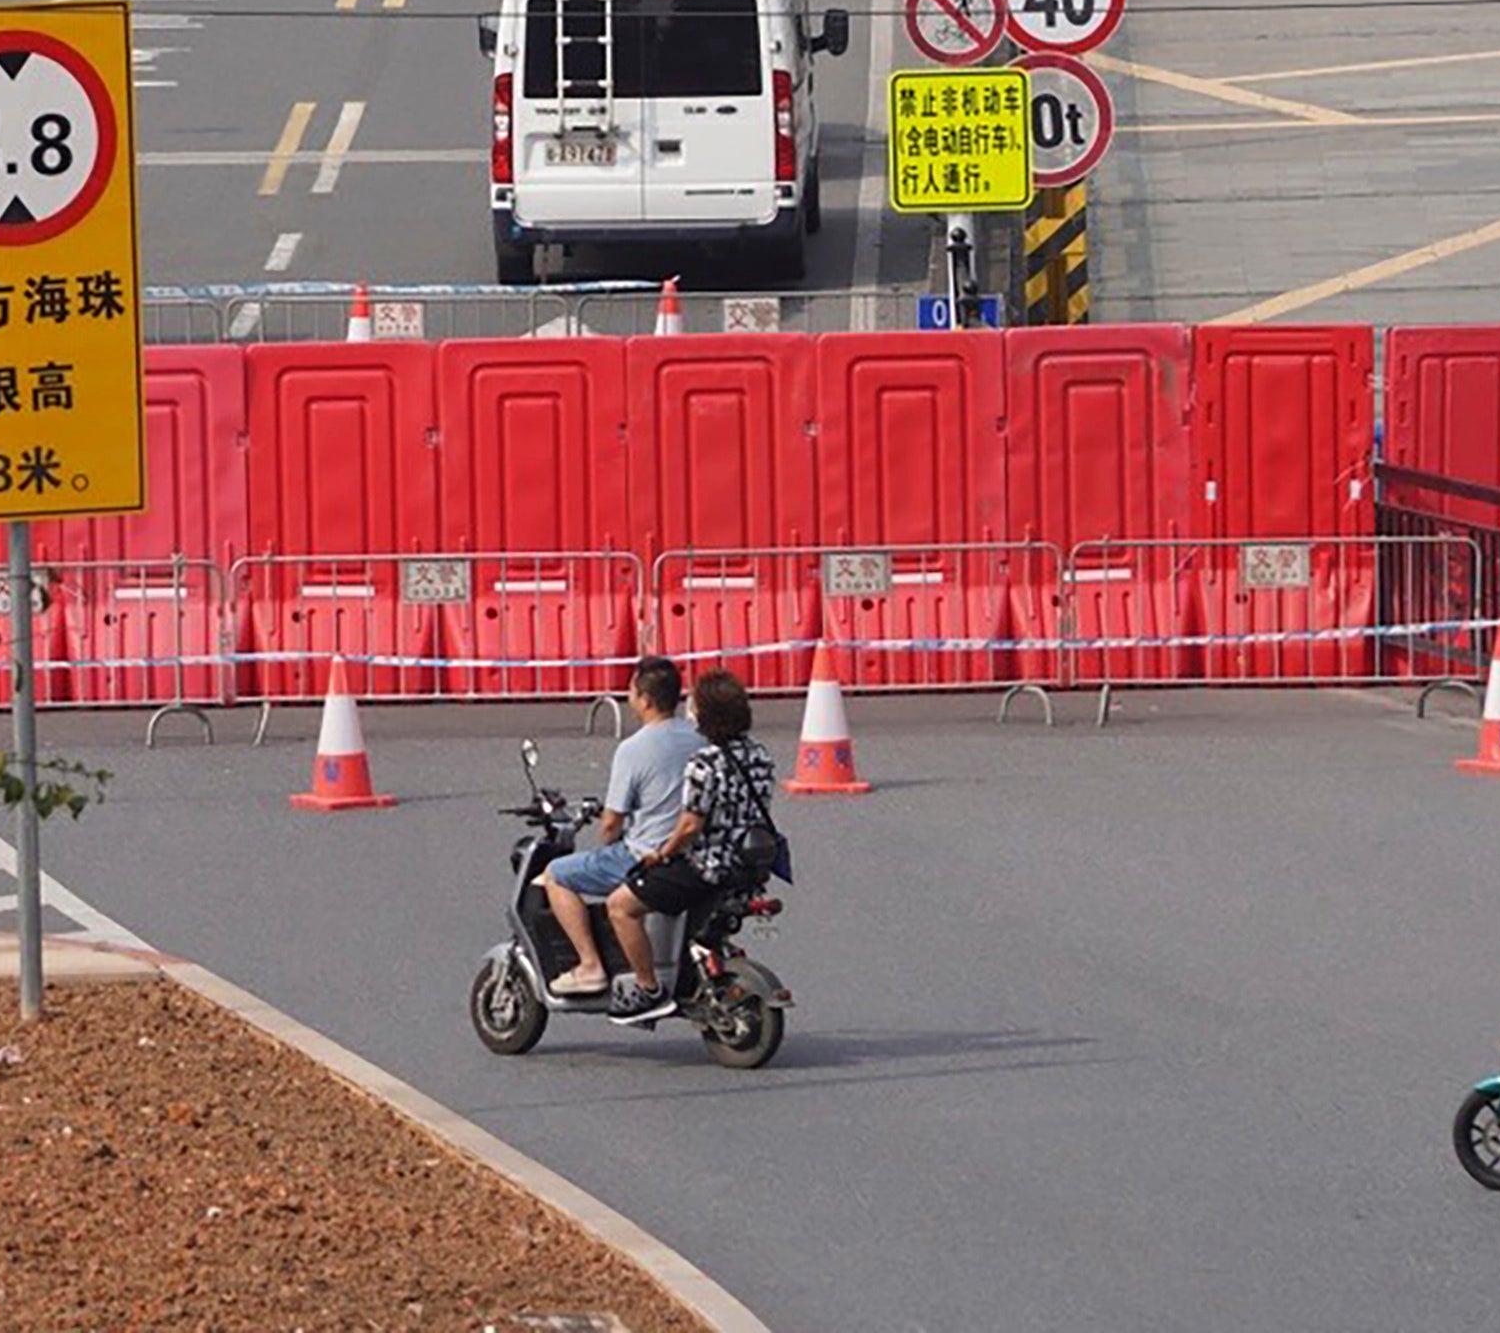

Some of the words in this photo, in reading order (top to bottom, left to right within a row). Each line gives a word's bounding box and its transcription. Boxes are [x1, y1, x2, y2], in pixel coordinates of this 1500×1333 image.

[899, 85, 1021, 118] 禁止非机动车
[1031, 93, 1085, 149] 0t
